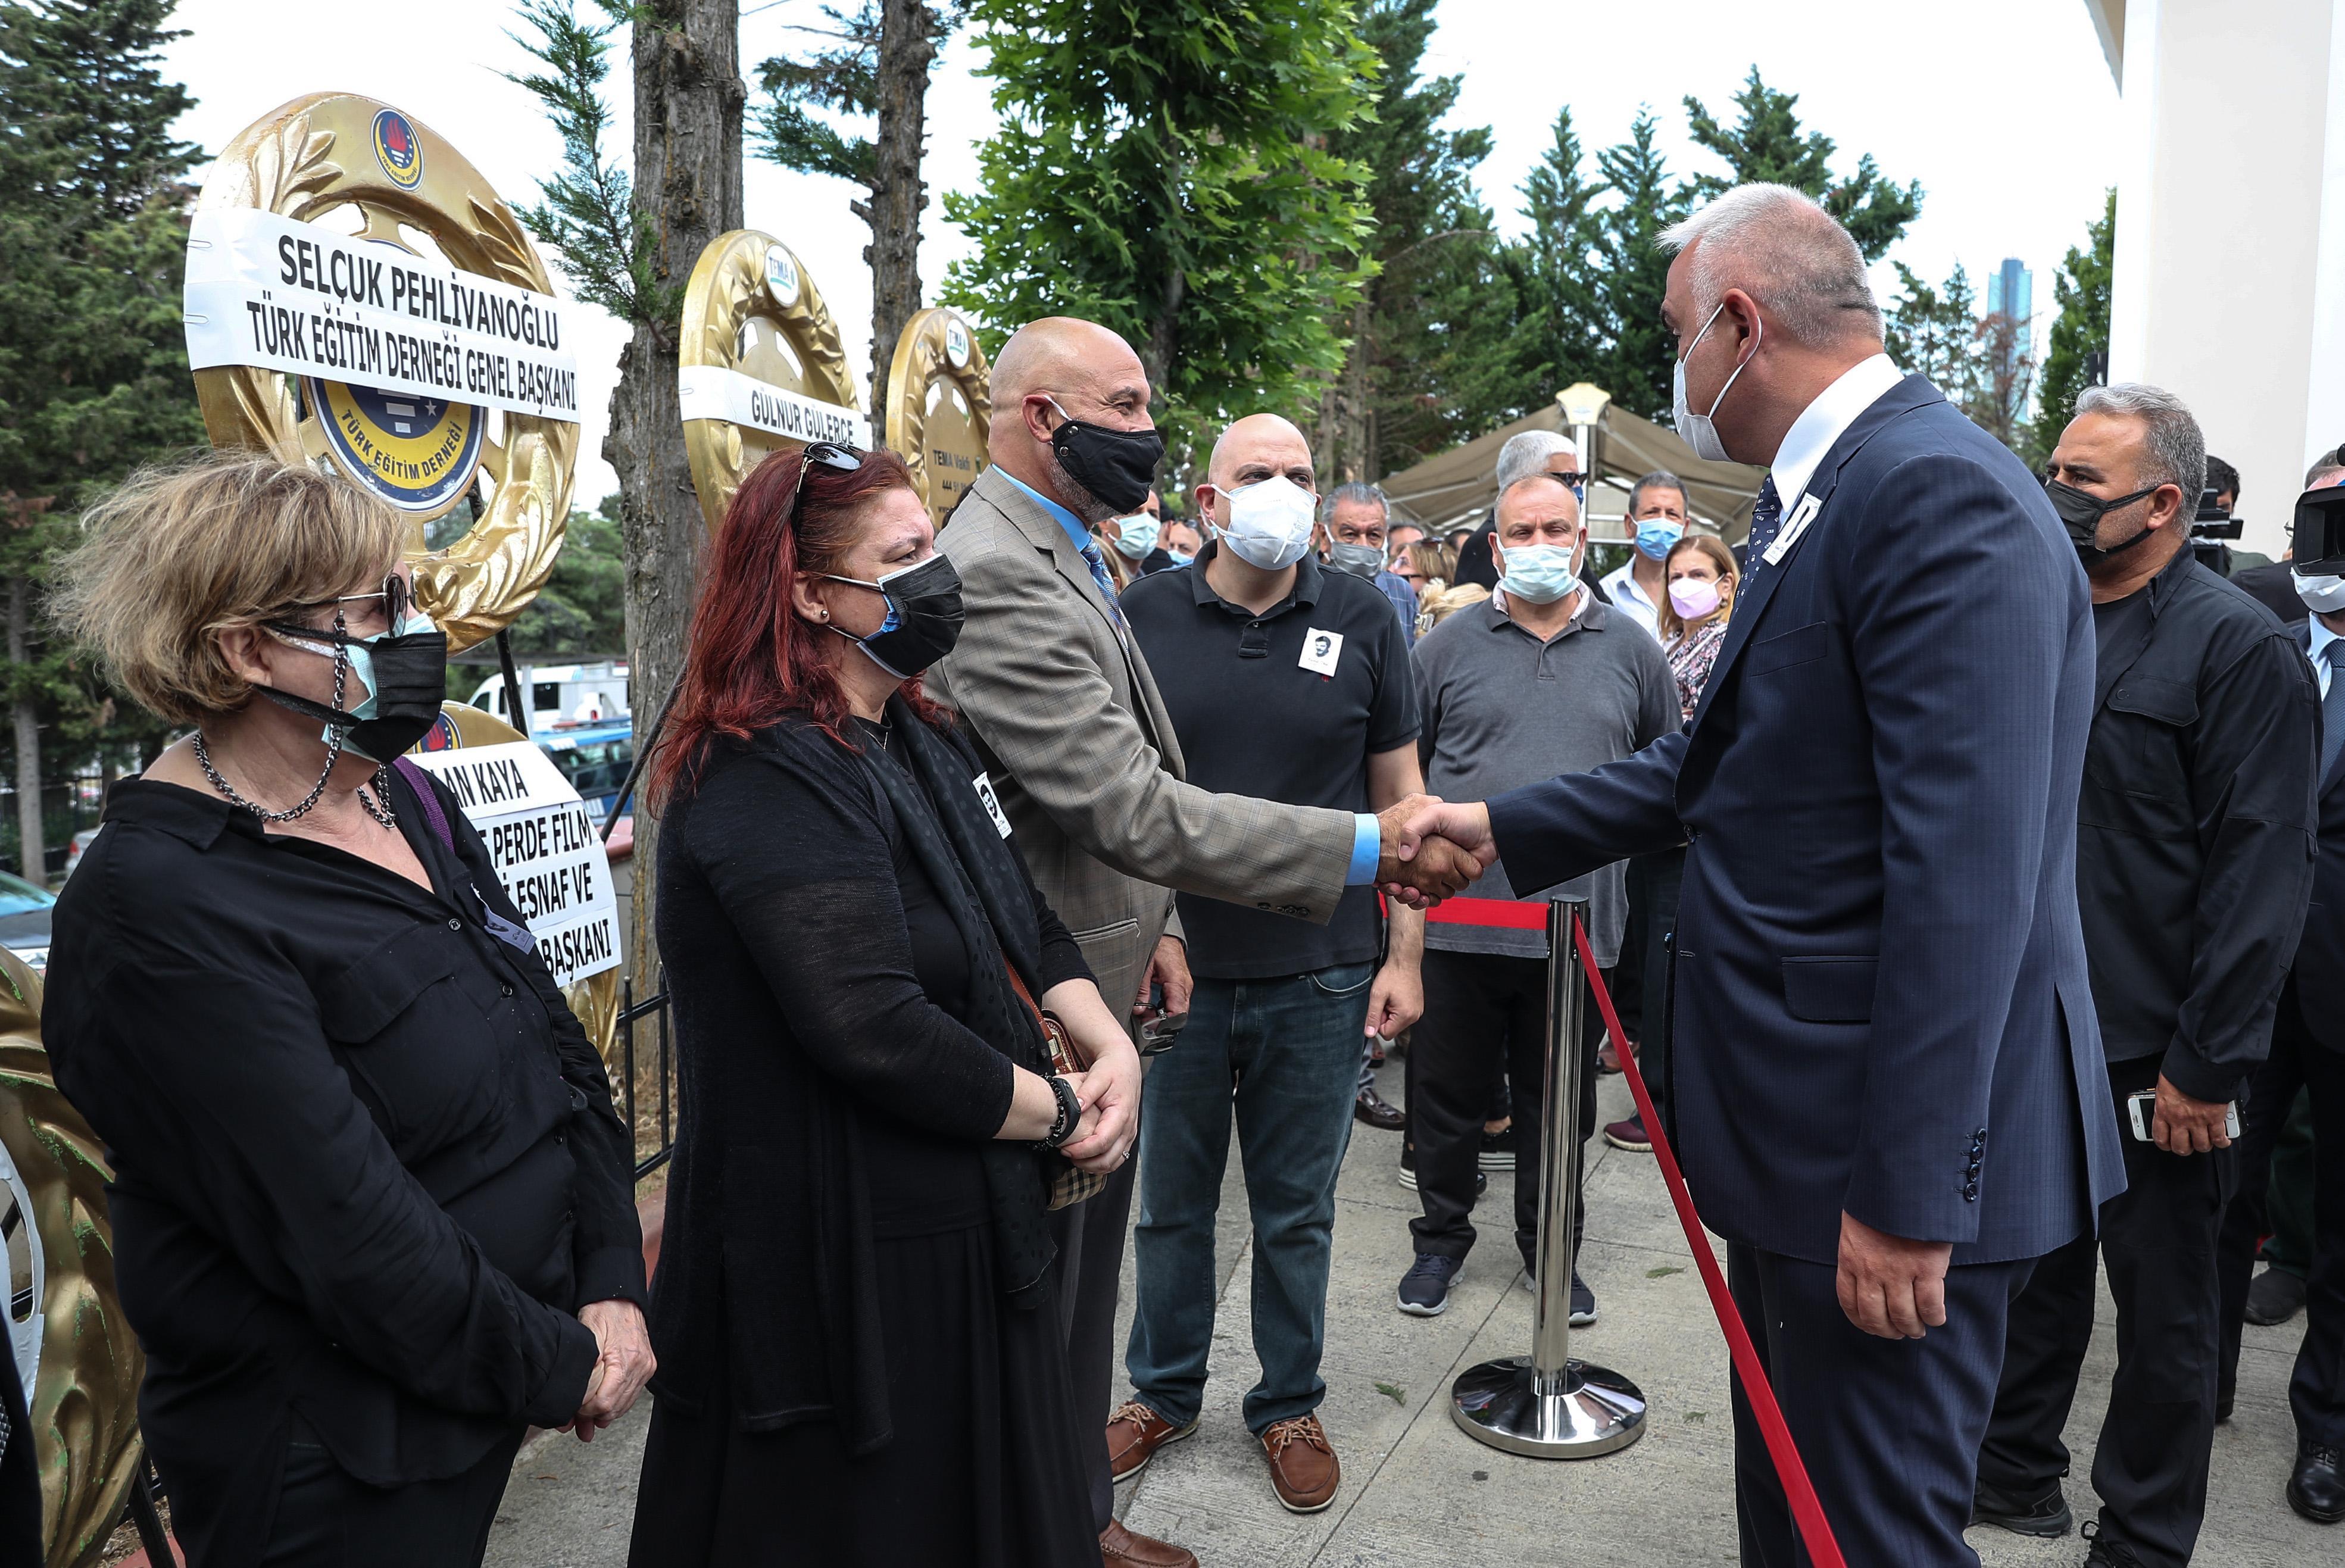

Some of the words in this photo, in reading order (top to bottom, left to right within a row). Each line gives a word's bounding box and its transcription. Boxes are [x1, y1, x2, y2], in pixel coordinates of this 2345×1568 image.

[278, 235, 385, 308] SELÇUK
[391, 266, 558, 351] PEHLİVANOĞLU
[246, 289, 309, 361] TÜRK
[311, 301, 382, 376] EĞİTİM
[385, 329, 463, 391] DERNEĞİ
[466, 349, 514, 399] GENEL
[517, 360, 576, 416] BAŞKANI
[751, 387, 803, 435] GÜLNUR
[341, 408, 374, 457] TÜRK
[374, 449, 420, 480] EĞİTİM
[420, 420, 463, 477] DERNEĞİ
[933, 449, 953, 467] TEMA
[472, 759, 529, 805] KAYA
[493, 817, 548, 869] PERDE
[551, 802, 592, 855] FİLM
[516, 868, 569, 921] ESNAF
[572, 862, 594, 904] VE
[541, 919, 613, 982] BAŞKANI
